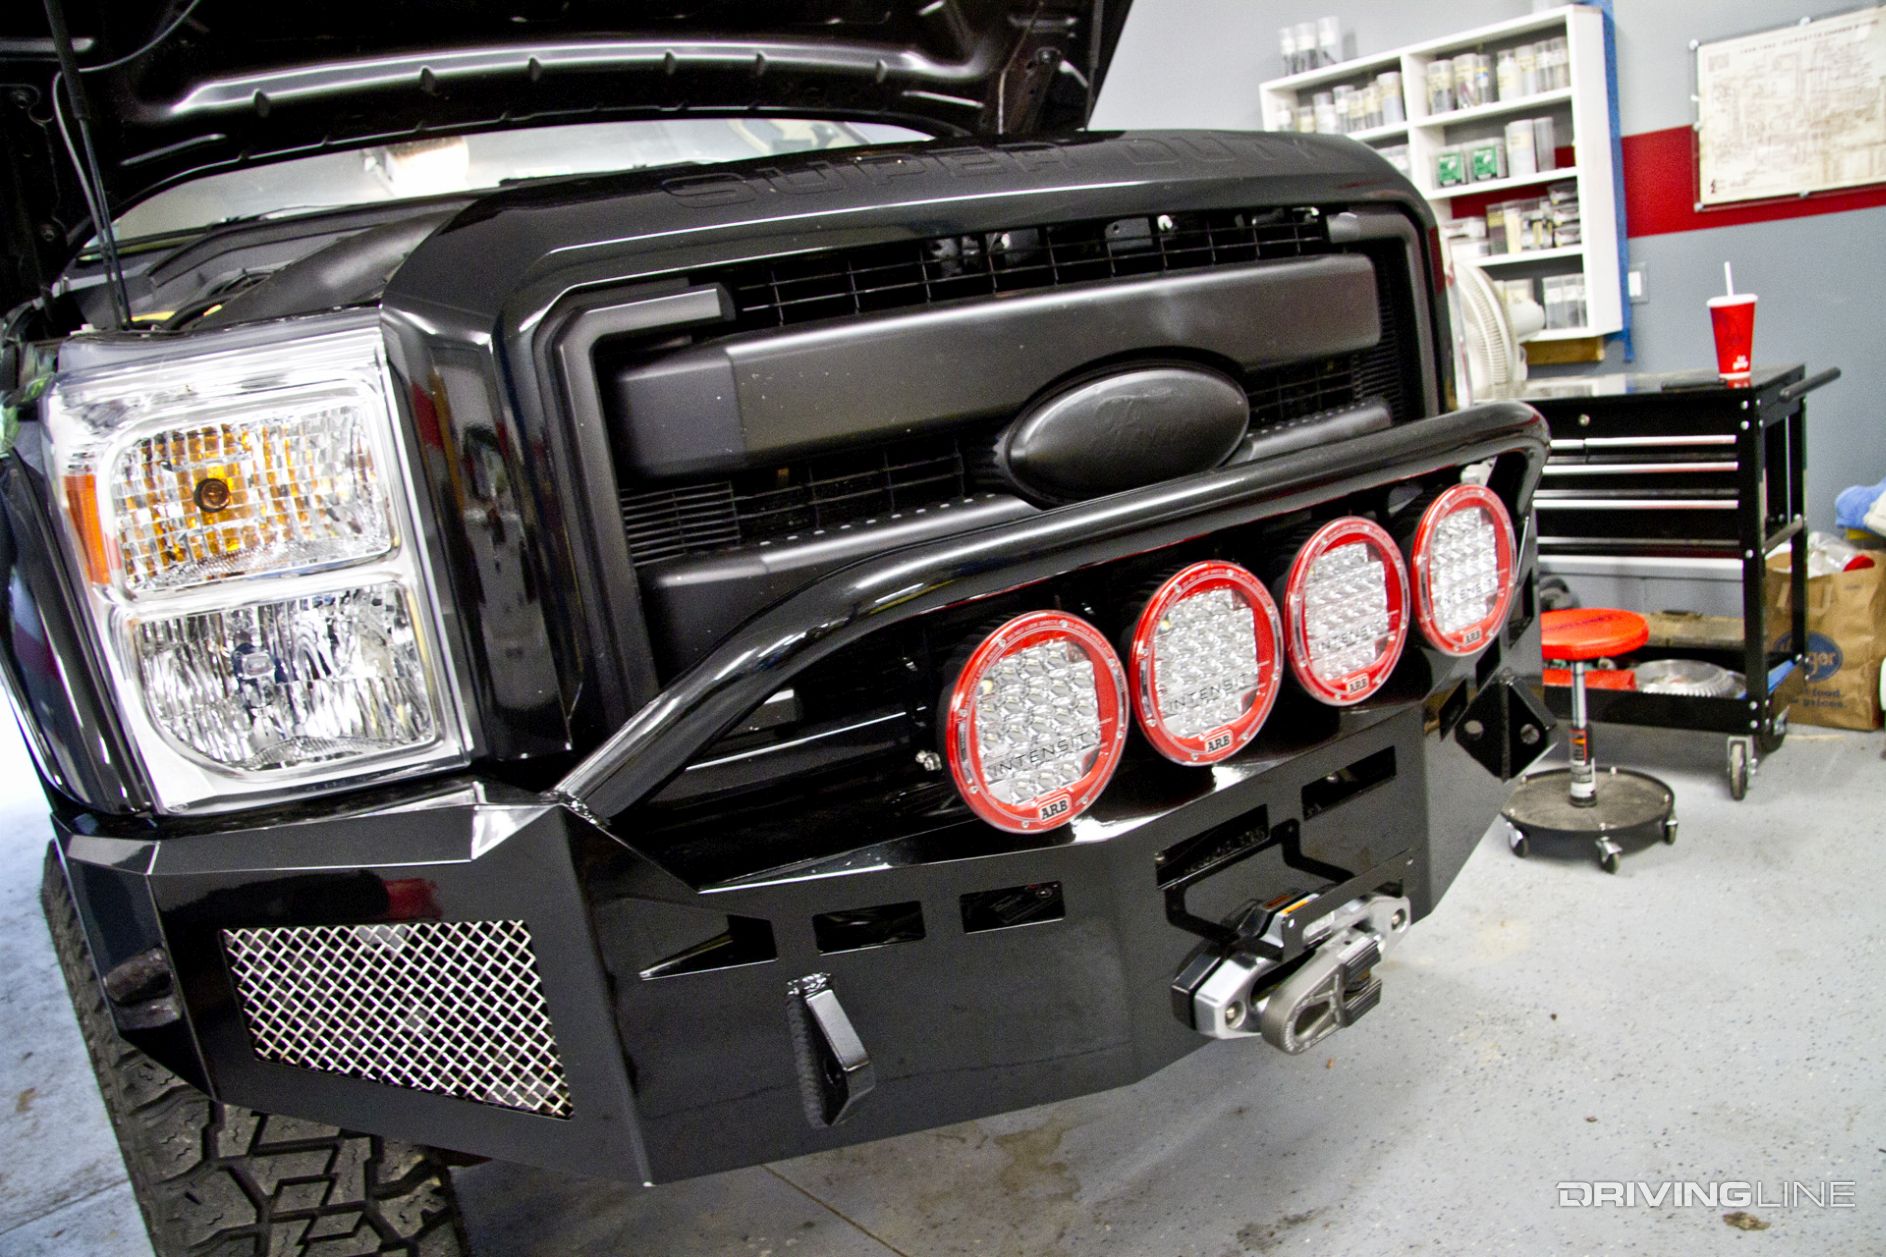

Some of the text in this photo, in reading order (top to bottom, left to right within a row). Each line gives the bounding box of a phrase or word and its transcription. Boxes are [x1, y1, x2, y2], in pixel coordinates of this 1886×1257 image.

[661, 141, 1070, 209] SUPER
[1208, 735, 1230, 753] ARB
[1041, 800, 1068, 820] ARB
